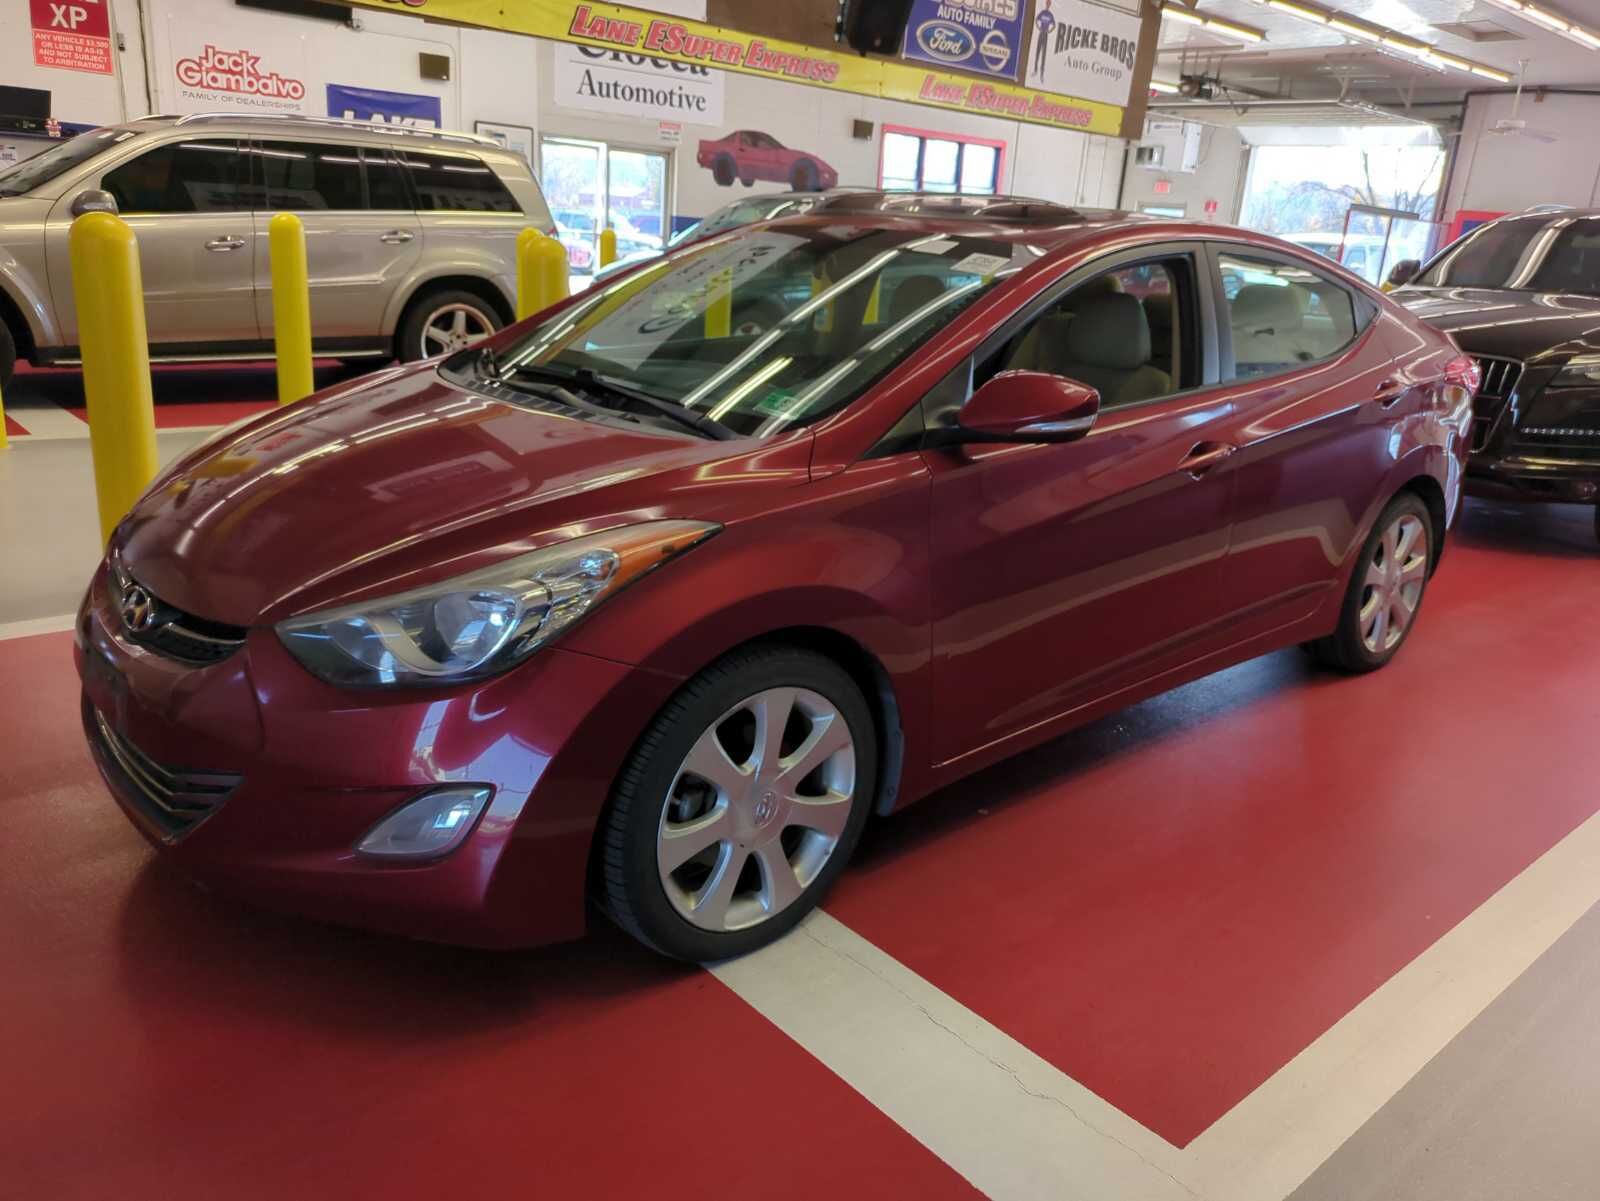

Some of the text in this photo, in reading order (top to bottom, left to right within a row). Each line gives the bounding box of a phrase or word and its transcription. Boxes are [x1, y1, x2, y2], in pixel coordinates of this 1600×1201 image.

[49, 3, 88, 30] XP
[937, 4, 998, 30] AUTO FAMILY
[35, 32, 52, 41] ANY
[52, 34, 84, 44] VEHICLE
[40, 40, 54, 49] OR
[54, 42, 74, 51] LESS
[568, 5, 642, 47] LANE
[743, 40, 839, 83] EXPRESS
[929, 27, 964, 55] Ford
[1054, 22, 1136, 71] RICKE BROS
[39, 48, 108, 63] AND NOT SUBJECT
[43, 56, 105, 70] TO ARBITRATION
[199, 44, 261, 78] Jack
[1064, 55, 1123, 82] Auto Group
[176, 58, 305, 100] Giambalvo
[576, 68, 707, 112] Automotive
[182, 90, 219, 102] FAMILY
[221, 95, 234, 104] OF
